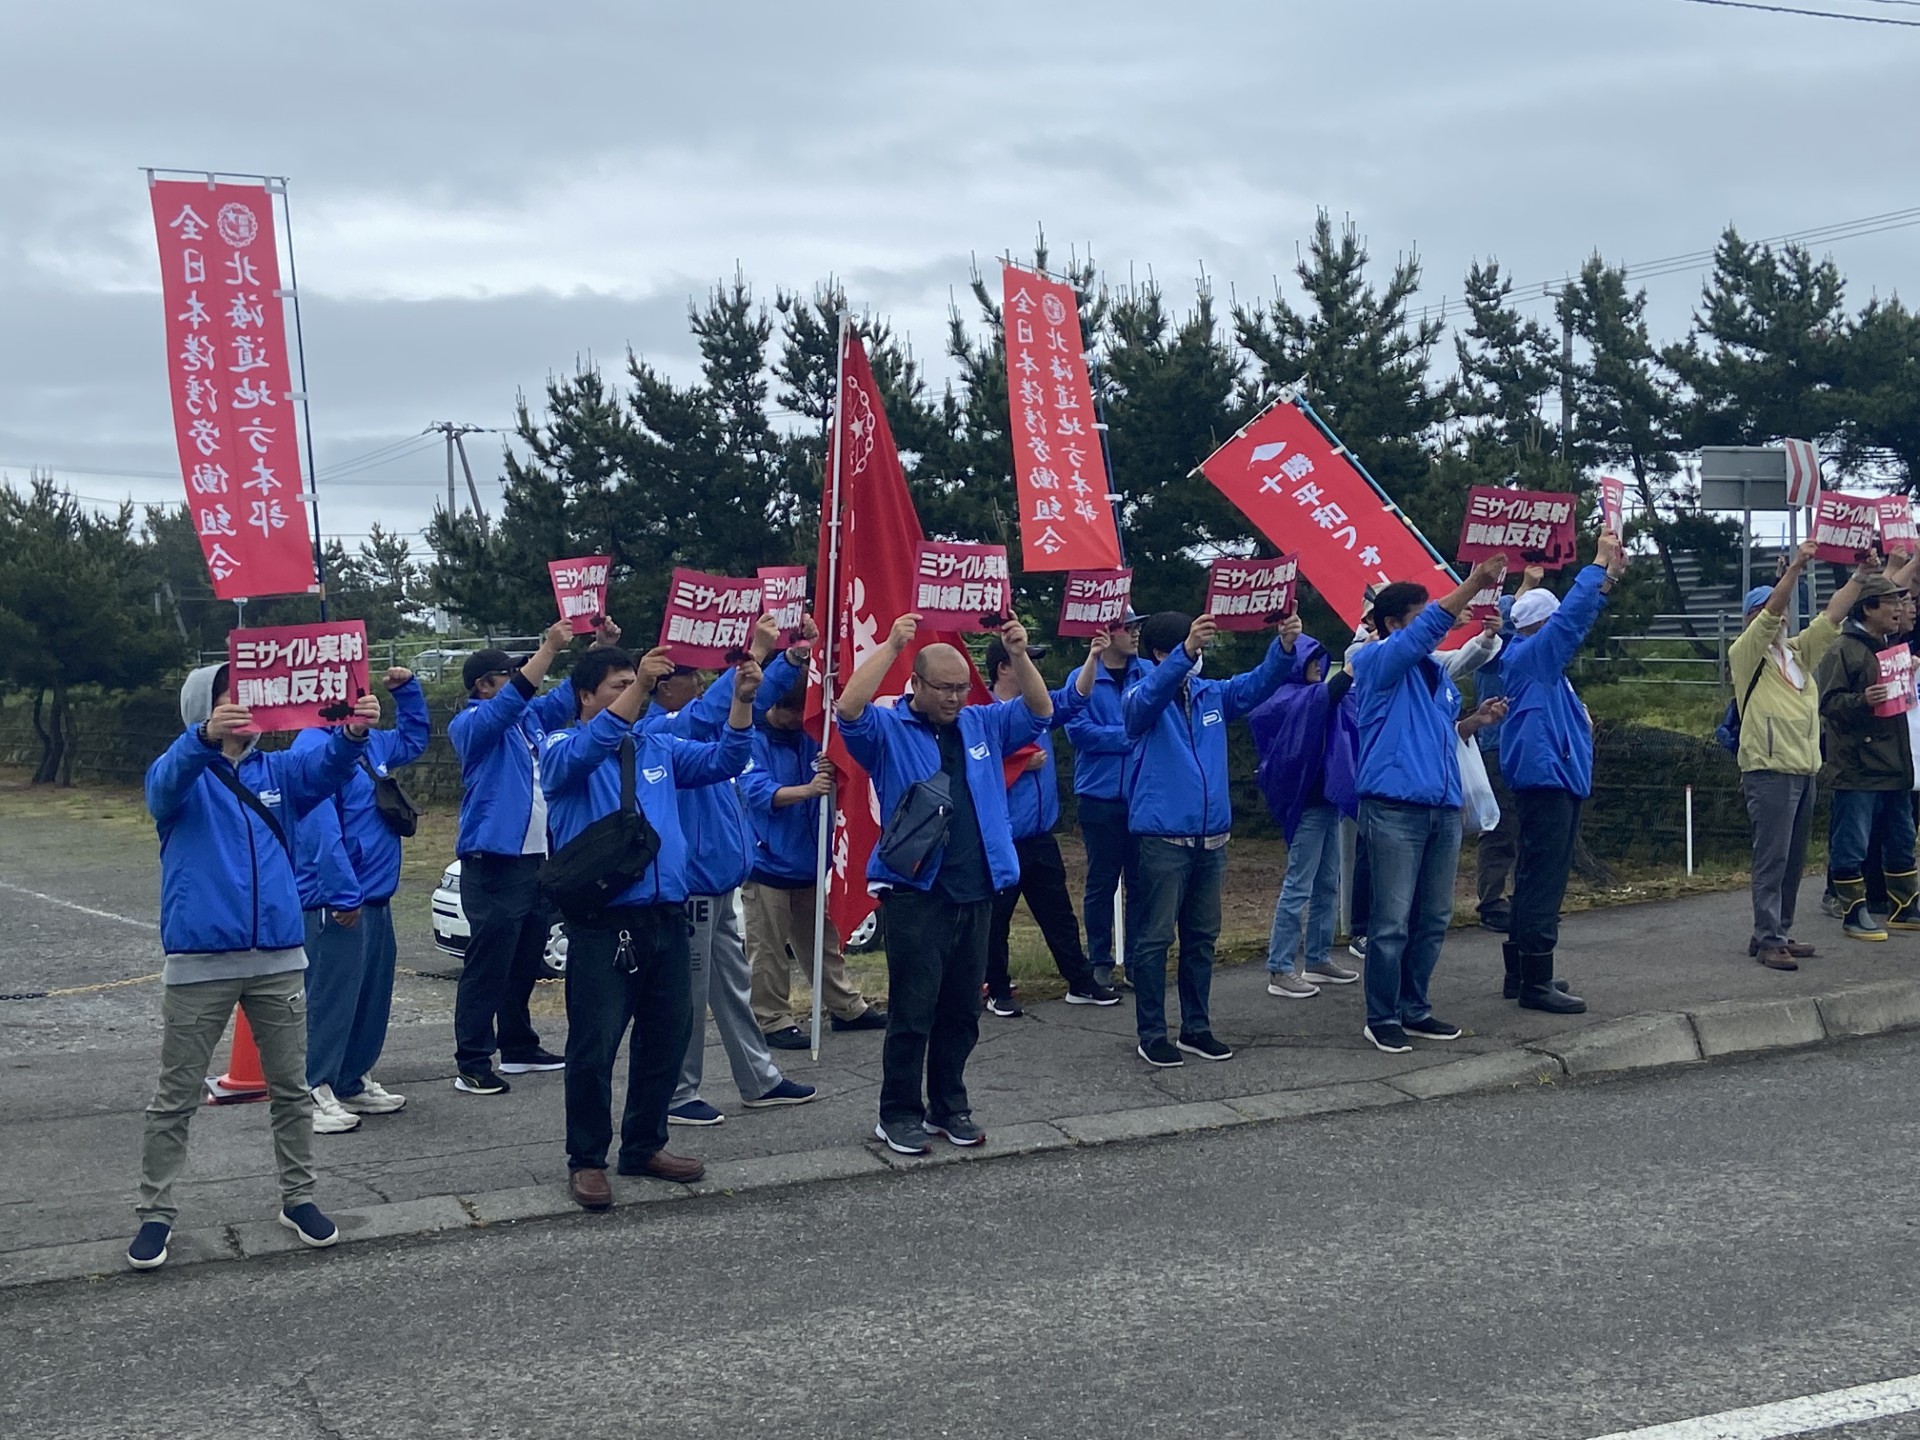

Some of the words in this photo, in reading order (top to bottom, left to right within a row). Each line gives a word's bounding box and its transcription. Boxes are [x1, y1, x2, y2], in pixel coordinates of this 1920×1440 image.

[1471, 495, 1570, 524] ミサイル実射
[1465, 522, 1551, 549] 訓練反対
[1816, 524, 1872, 549] 訓練反対
[555, 565, 607, 588] ミサイル実射
[1213, 558, 1297, 589] ミサイル実射
[562, 587, 600, 618] 訓練反対
[674, 581, 762, 614] ミサイル実射
[917, 582, 1002, 612] 訓練反対
[1065, 596, 1124, 622] 訓練反対
[1210, 584, 1288, 615] 訓練反対
[667, 615, 750, 648] 訓練反対
[236, 632, 363, 669] ミサイル実射
[237, 665, 349, 708] 訓練反対
